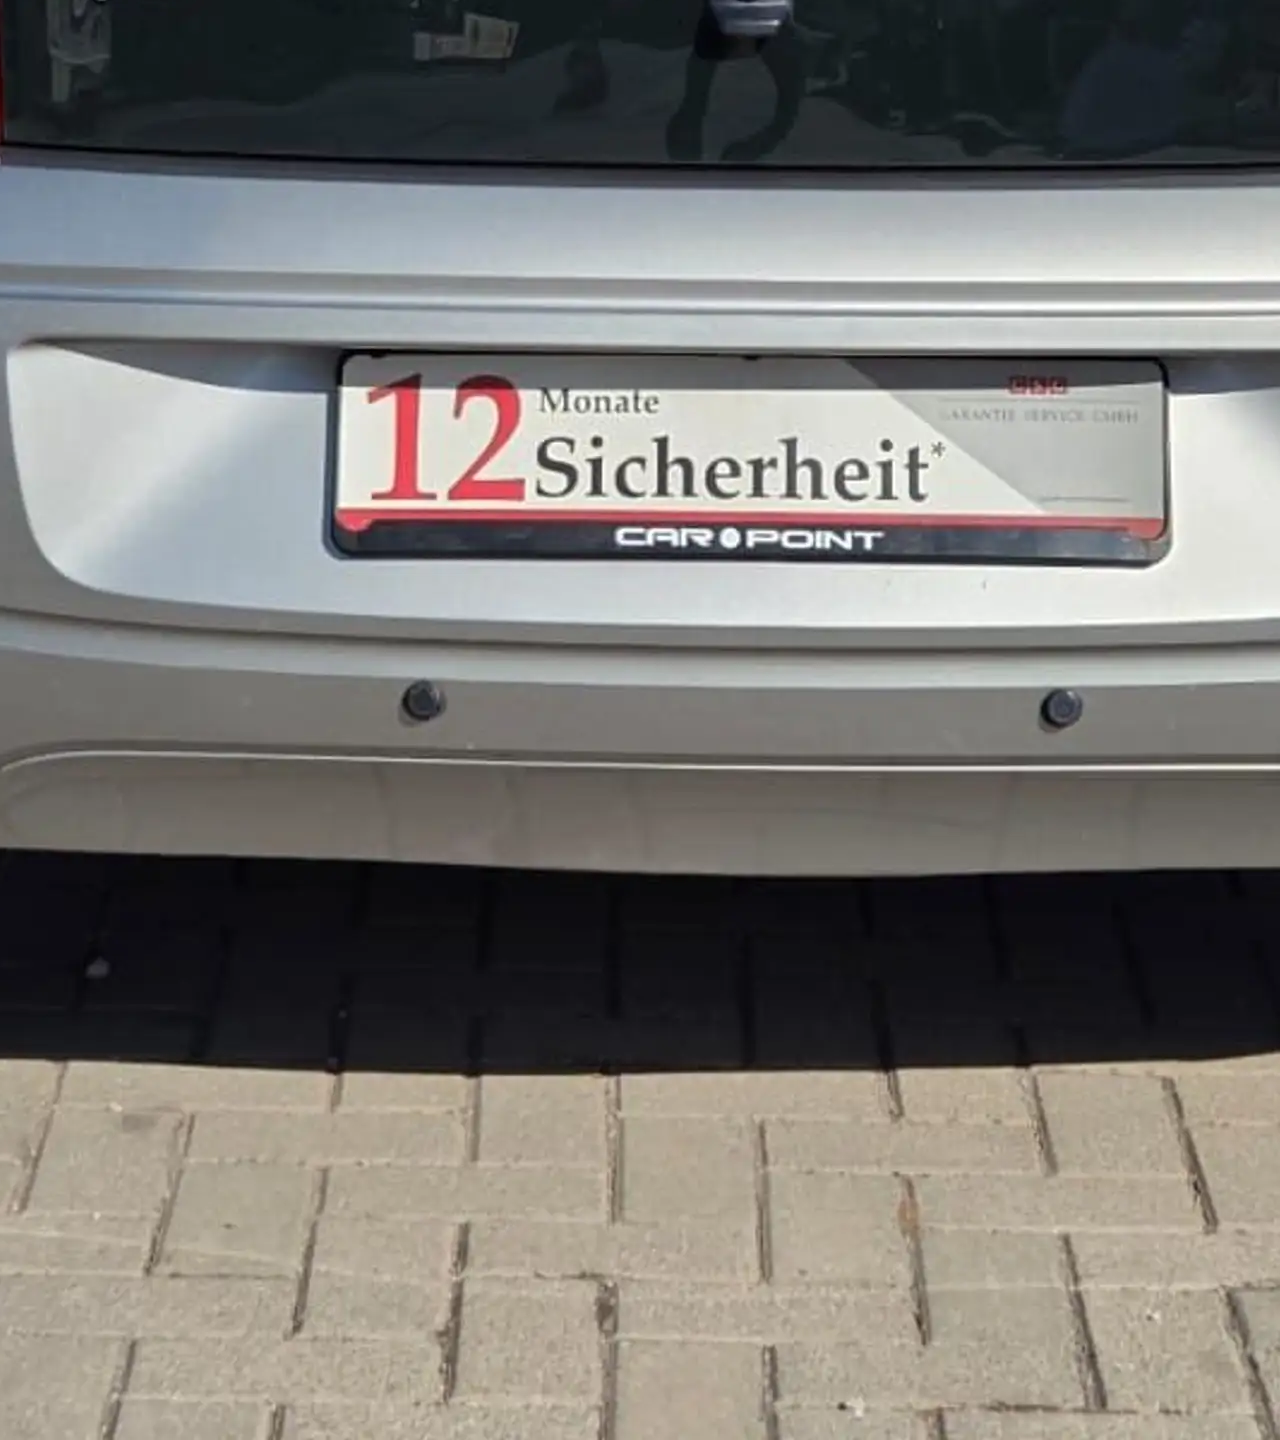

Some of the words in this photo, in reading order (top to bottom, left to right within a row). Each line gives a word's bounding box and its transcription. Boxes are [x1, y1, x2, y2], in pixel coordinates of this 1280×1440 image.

[539, 386, 661, 415] Monate
[367, 372, 527, 502] 12
[614, 526, 715, 548] CAR
[746, 528, 885, 551] POINT
